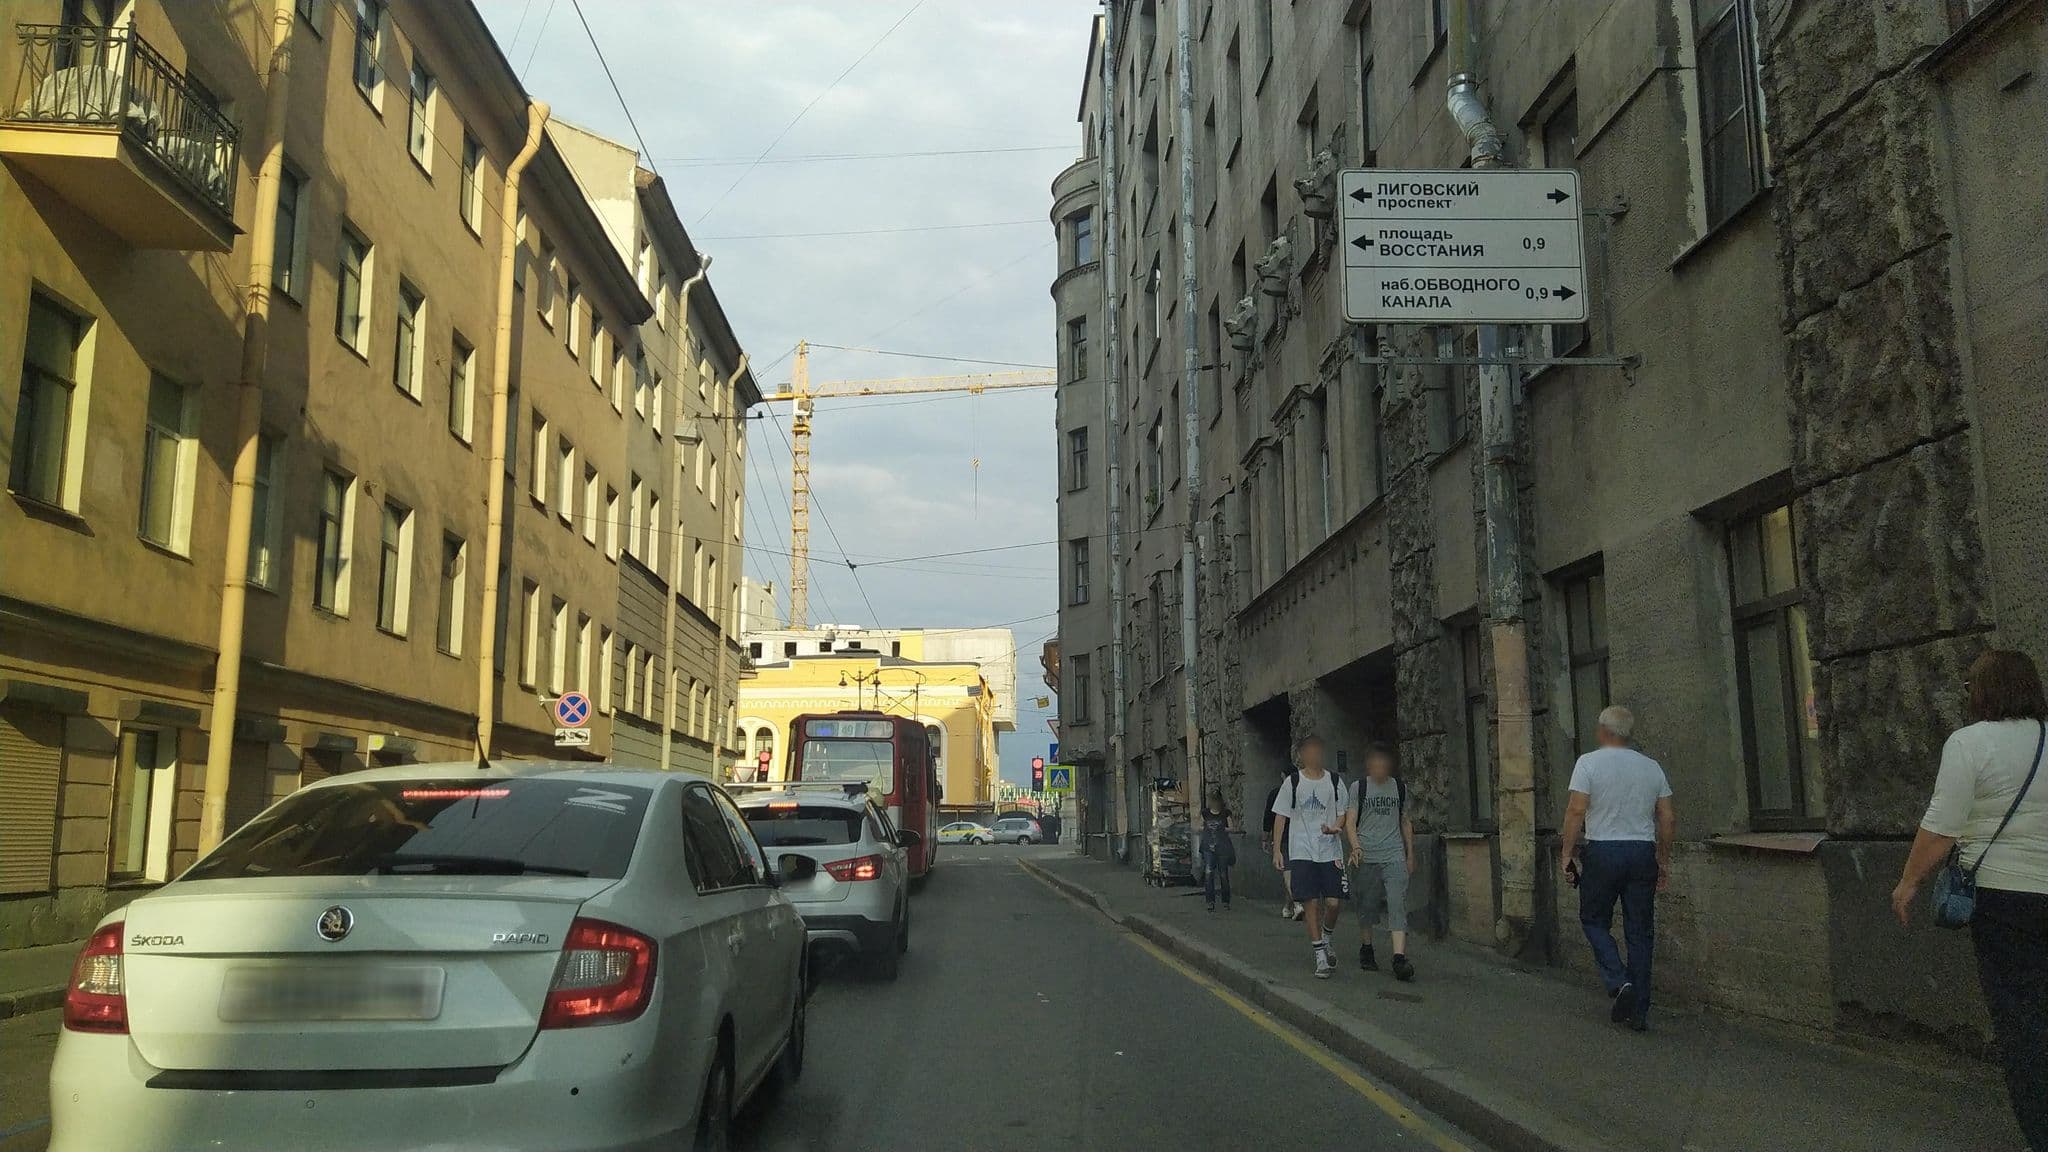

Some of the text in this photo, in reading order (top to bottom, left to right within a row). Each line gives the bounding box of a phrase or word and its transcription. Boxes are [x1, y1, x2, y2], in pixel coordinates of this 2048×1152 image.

[1376, 181, 1479, 196] ЛИГОВСКИЙ
[1378, 198, 1453, 211] проспект
[1379, 229, 1453, 242] площадь
[1380, 244, 1484, 257] ВОССТАНИЯ
[1522, 237, 1546, 252] 0,9
[1525, 287, 1549, 302] 0,9
[1381, 295, 1452, 308] КАНАЛА
[493, 933, 550, 944] RAPID
